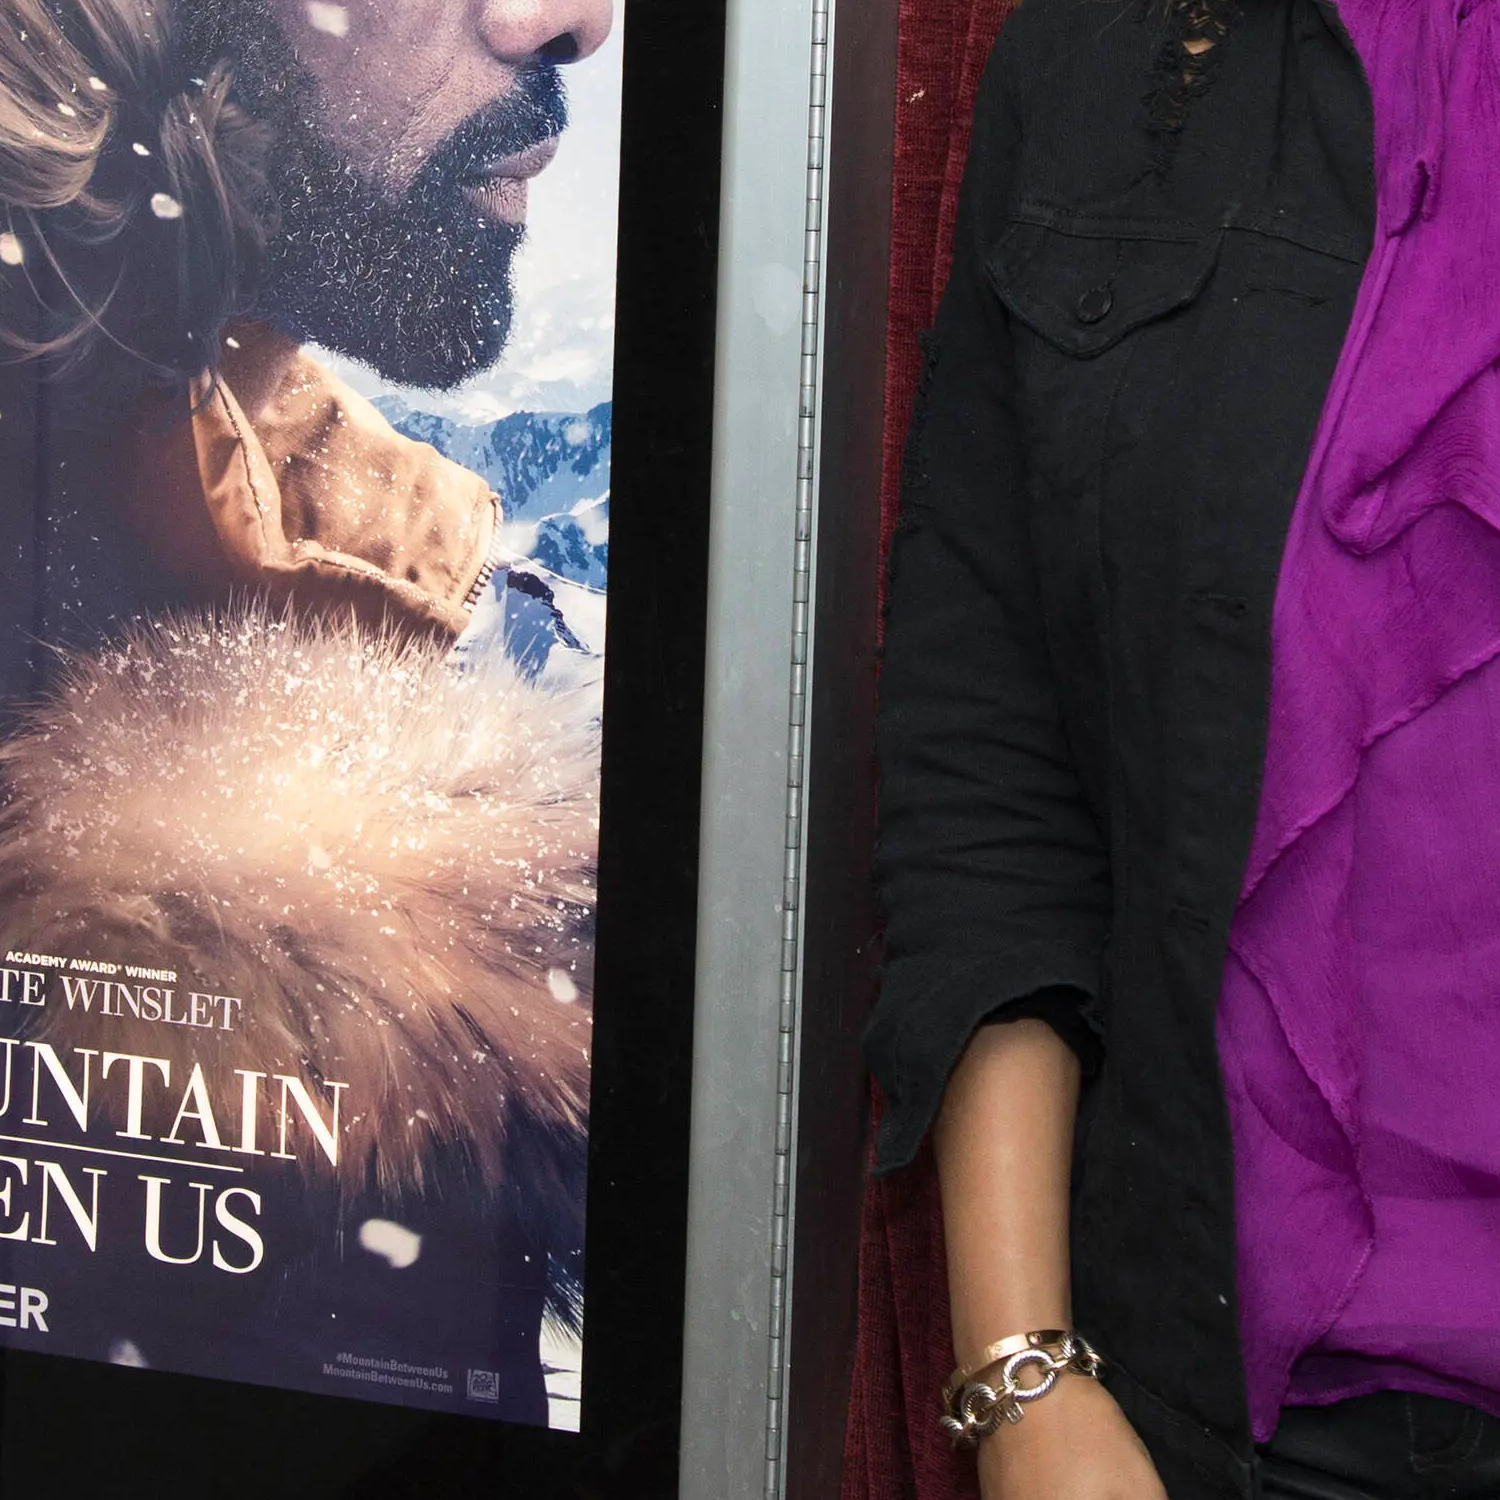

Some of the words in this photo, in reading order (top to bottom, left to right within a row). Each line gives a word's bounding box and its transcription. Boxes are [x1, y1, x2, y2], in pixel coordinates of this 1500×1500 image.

[5, 951, 67, 969] ACADEMY
[125, 965, 178, 983] WINNER
[59, 975, 241, 1031] WINSLET
[138, 1175, 265, 1274] US
